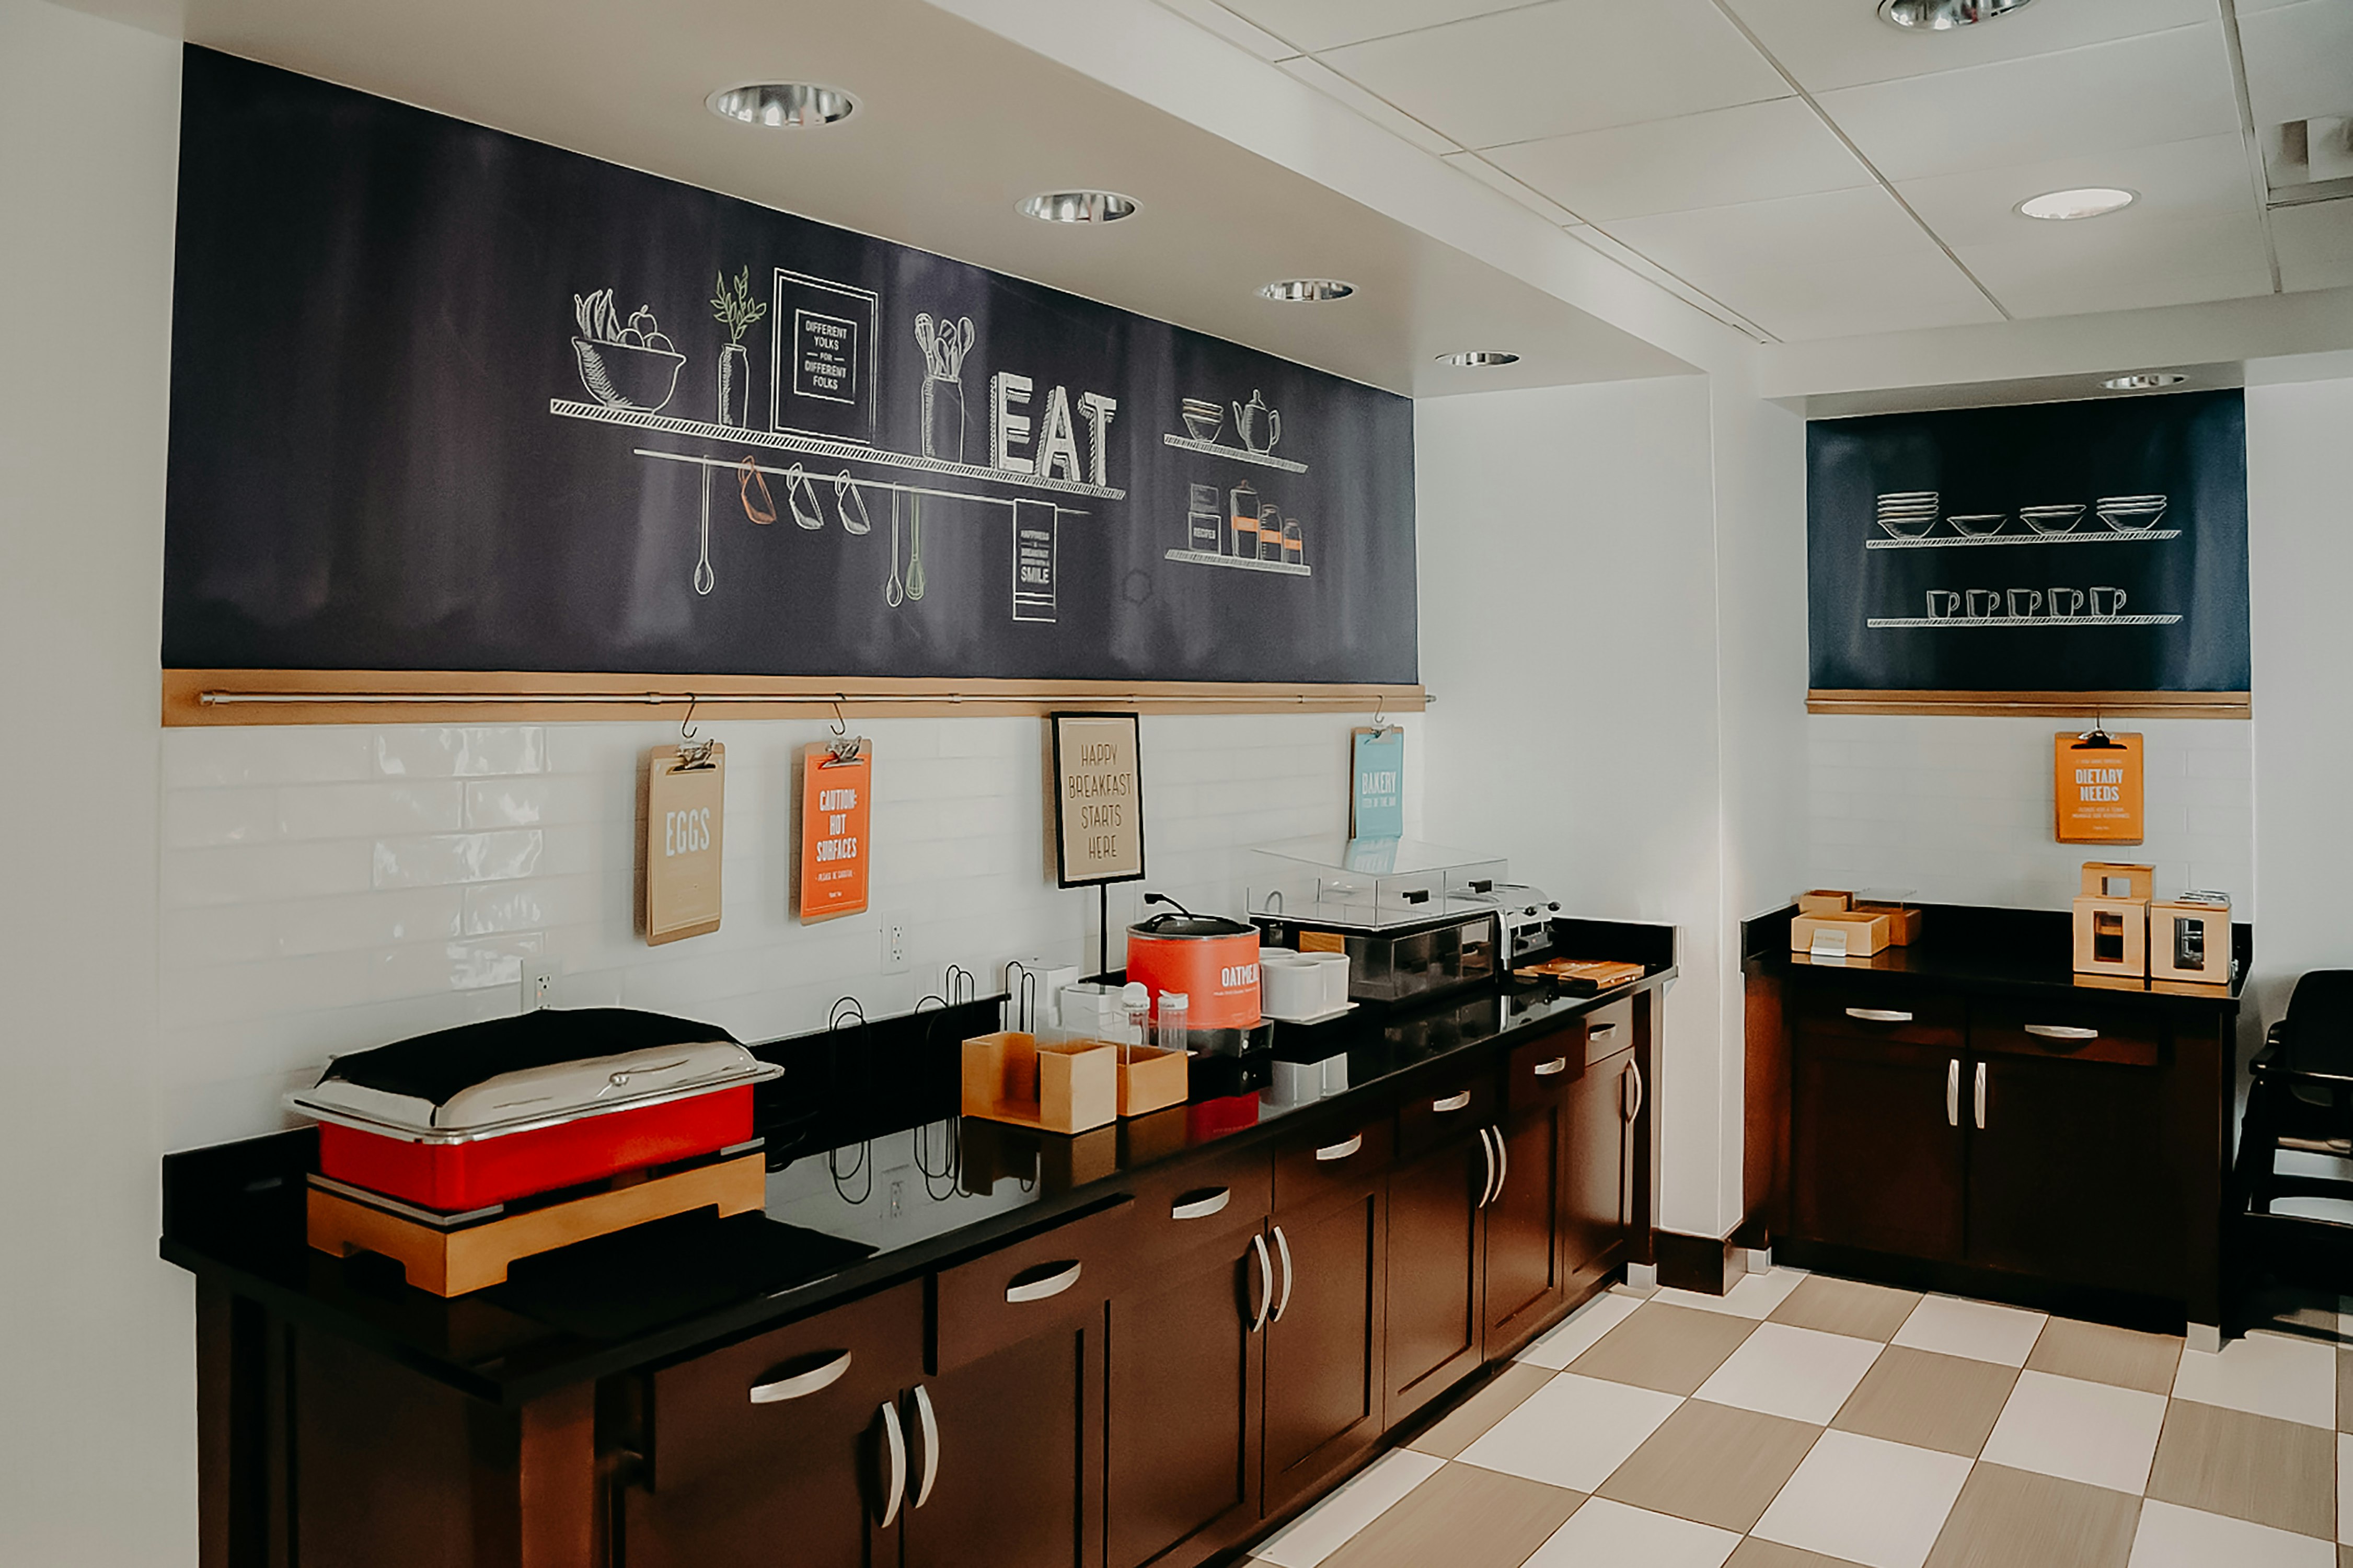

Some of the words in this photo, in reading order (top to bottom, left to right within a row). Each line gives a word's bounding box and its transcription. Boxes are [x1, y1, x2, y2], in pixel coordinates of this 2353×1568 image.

[805, 320, 847, 339] DIFFERENT
[814, 336, 839, 351] YOLKS
[820, 352, 832, 362] FOR
[804, 360, 847, 378] DIFFERENT
[813, 375, 838, 390] FOLKS
[990, 371, 1116, 487] EAT
[1021, 566, 1049, 584] SMILE
[1081, 744, 1117, 767] HAPPY
[1068, 773, 1132, 799] BREAKFAST
[1362, 771, 1397, 794] BAKERY
[2075, 769, 2123, 784] DIETARY
[2080, 786, 2120, 802] NEEDS
[829, 813, 847, 836] HOT
[1081, 804, 1122, 829] STARTS
[666, 806, 710, 857] EGGS
[816, 837, 857, 862] SURFACES
[1089, 835, 1117, 859] HERE
